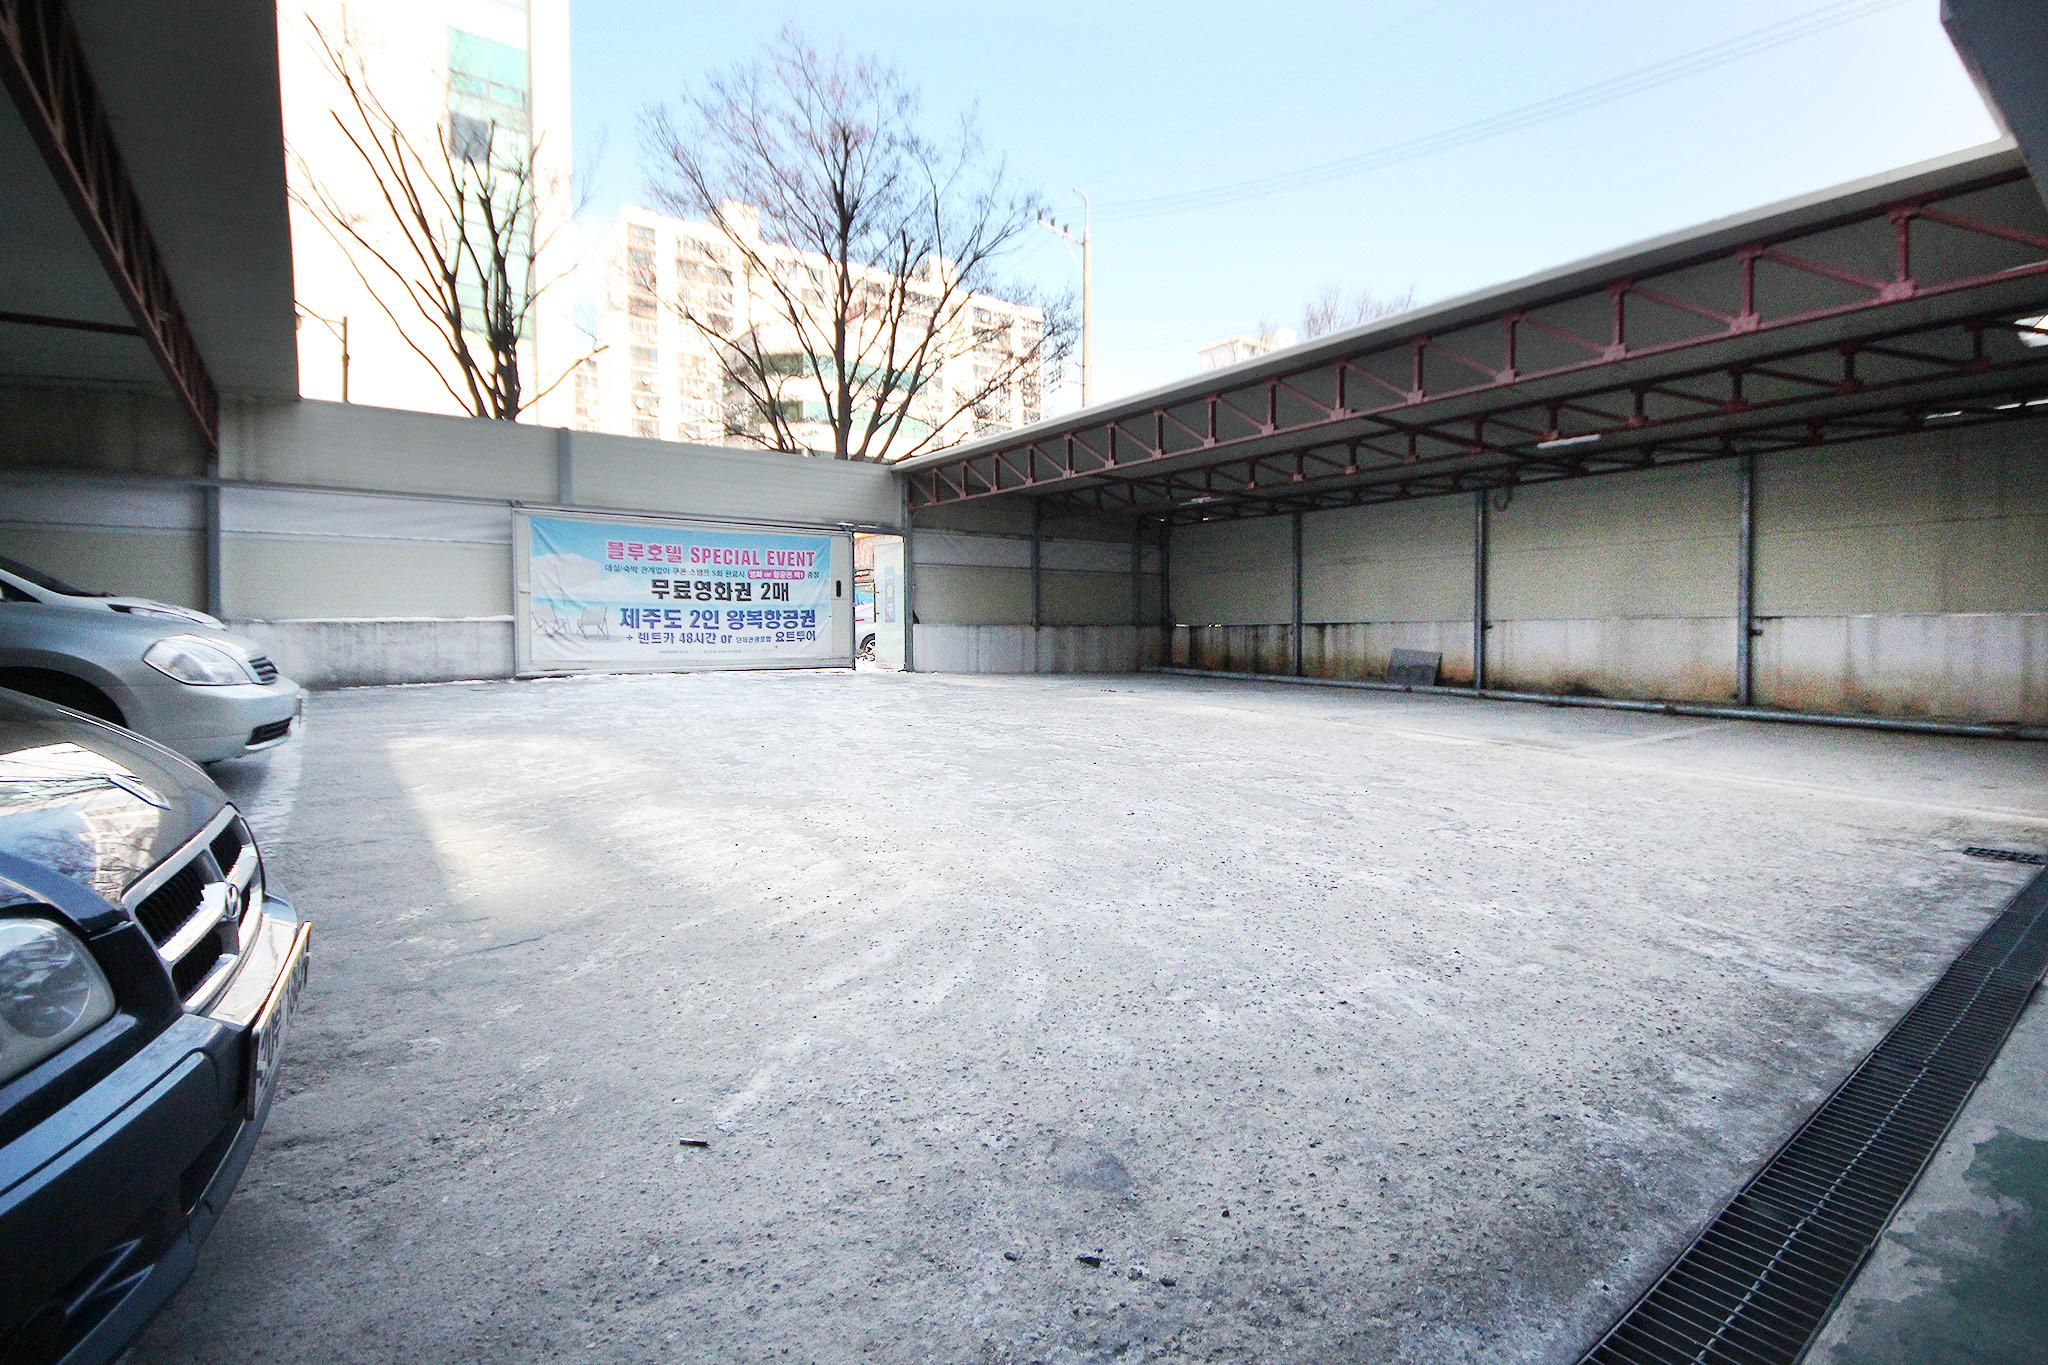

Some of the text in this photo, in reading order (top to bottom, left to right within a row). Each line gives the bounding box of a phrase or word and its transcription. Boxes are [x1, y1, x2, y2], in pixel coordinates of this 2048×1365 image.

[607, 541, 815, 567] 블루호텔 SPECIAL EVENT
[651, 579, 789, 602] 무료영화권 2매
[620, 608, 815, 630] 제주도 2인 왕복항공권
[638, 632, 675, 644] 렌트카
[679, 632, 716, 644] 48시간
[721, 634, 733, 643] or
[776, 630, 815, 642] 요트투어
